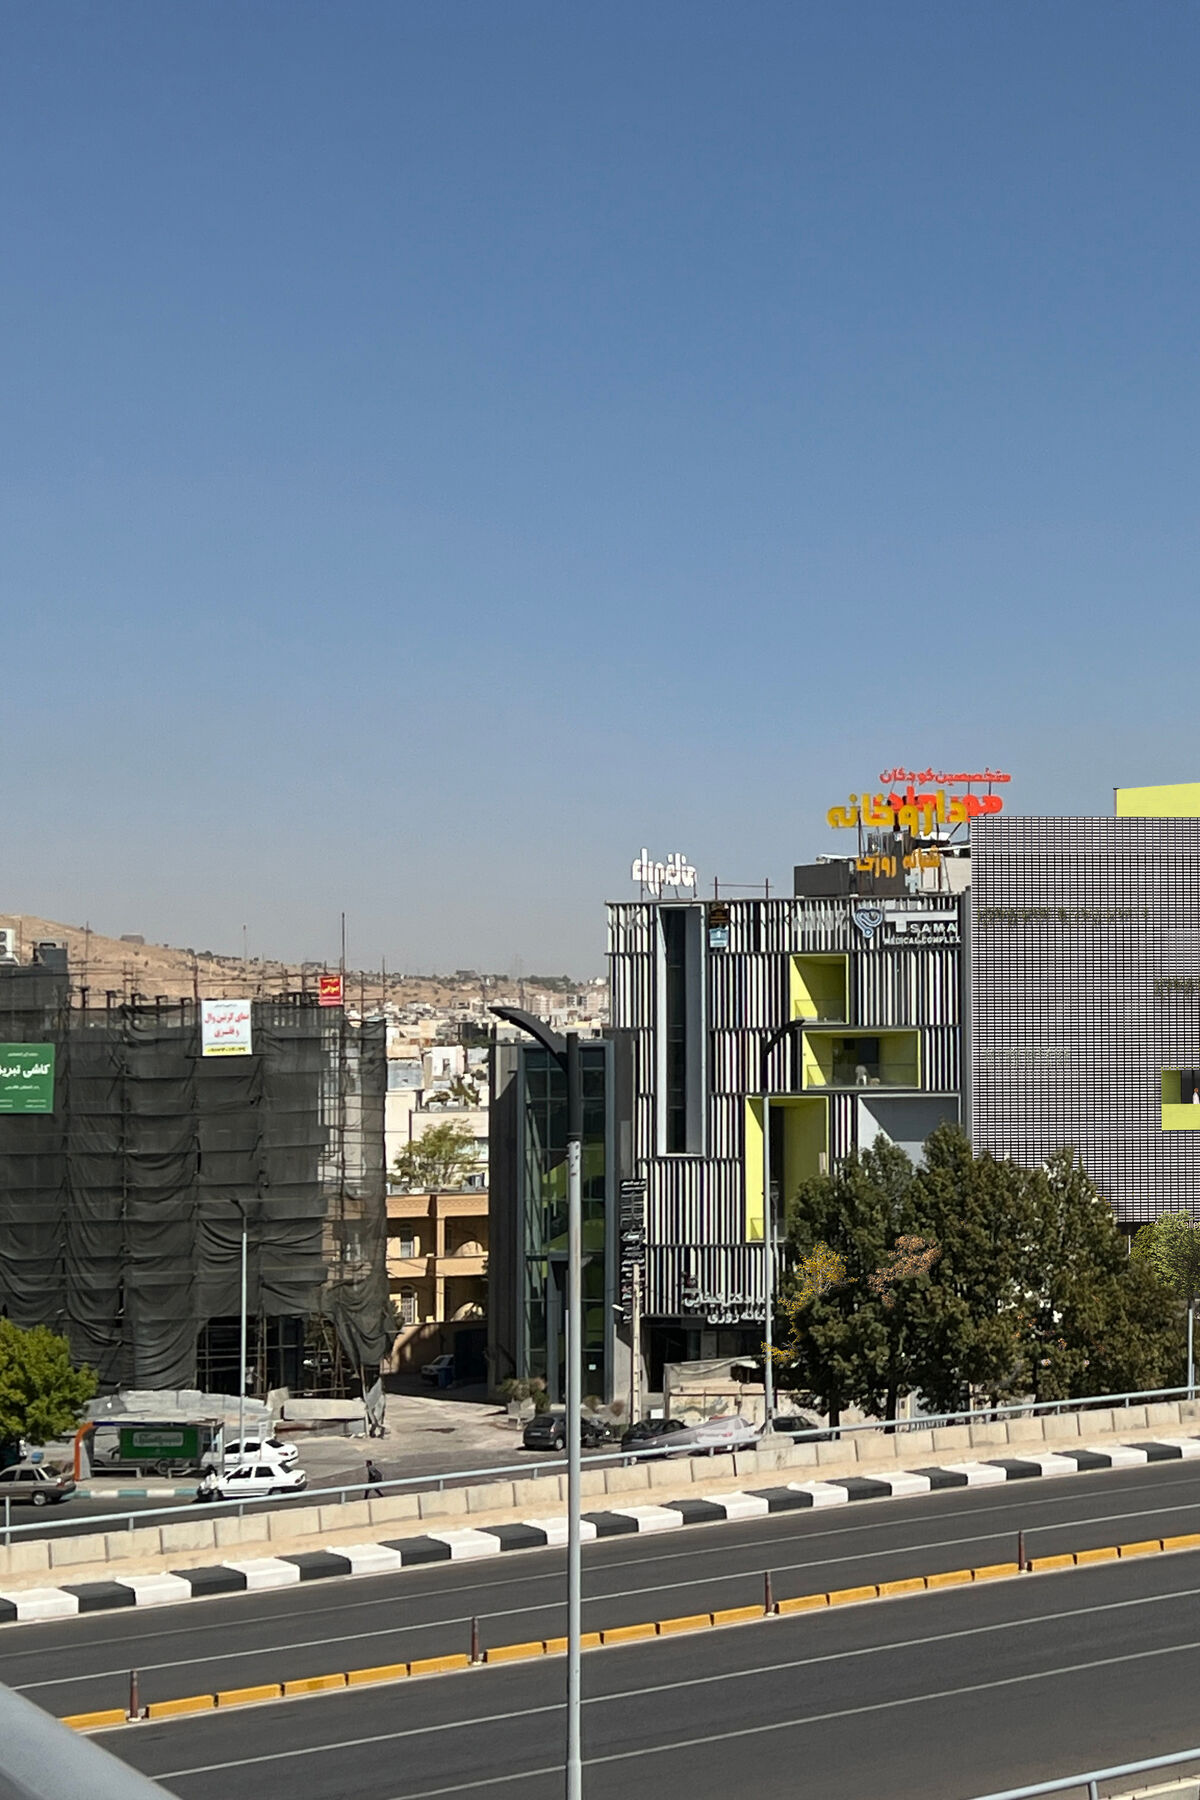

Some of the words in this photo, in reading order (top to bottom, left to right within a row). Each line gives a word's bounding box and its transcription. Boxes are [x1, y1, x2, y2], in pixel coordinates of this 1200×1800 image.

[827, 789, 968, 837] داروخانه
[910, 923, 957, 933] SAMA
[922, 935, 962, 944] COMPLEX
[23, 1063, 51, 1079] کاشی
